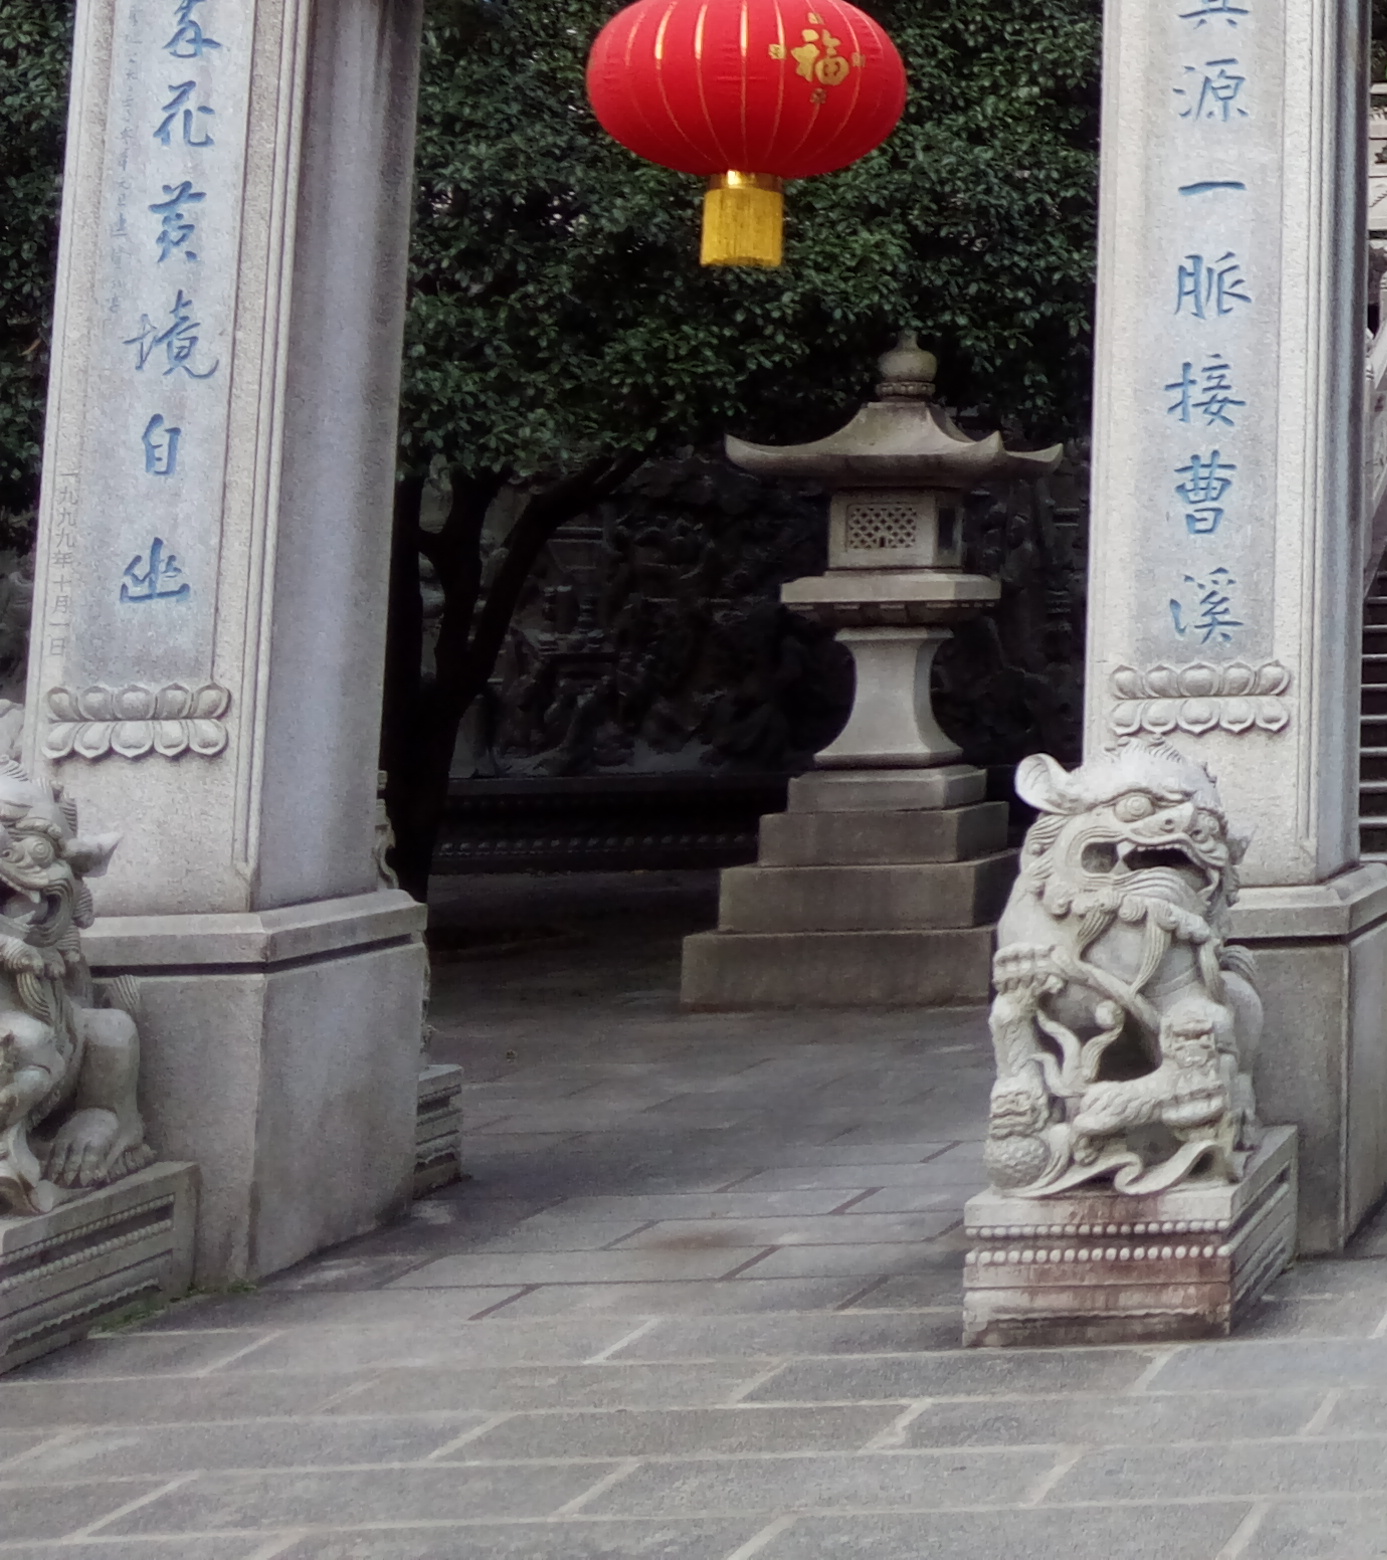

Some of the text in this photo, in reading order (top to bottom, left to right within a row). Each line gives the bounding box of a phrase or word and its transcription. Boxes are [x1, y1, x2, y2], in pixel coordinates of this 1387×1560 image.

[790, 29, 850, 85] 福
[49, 471, 80, 657] 一九九九年十月一日
